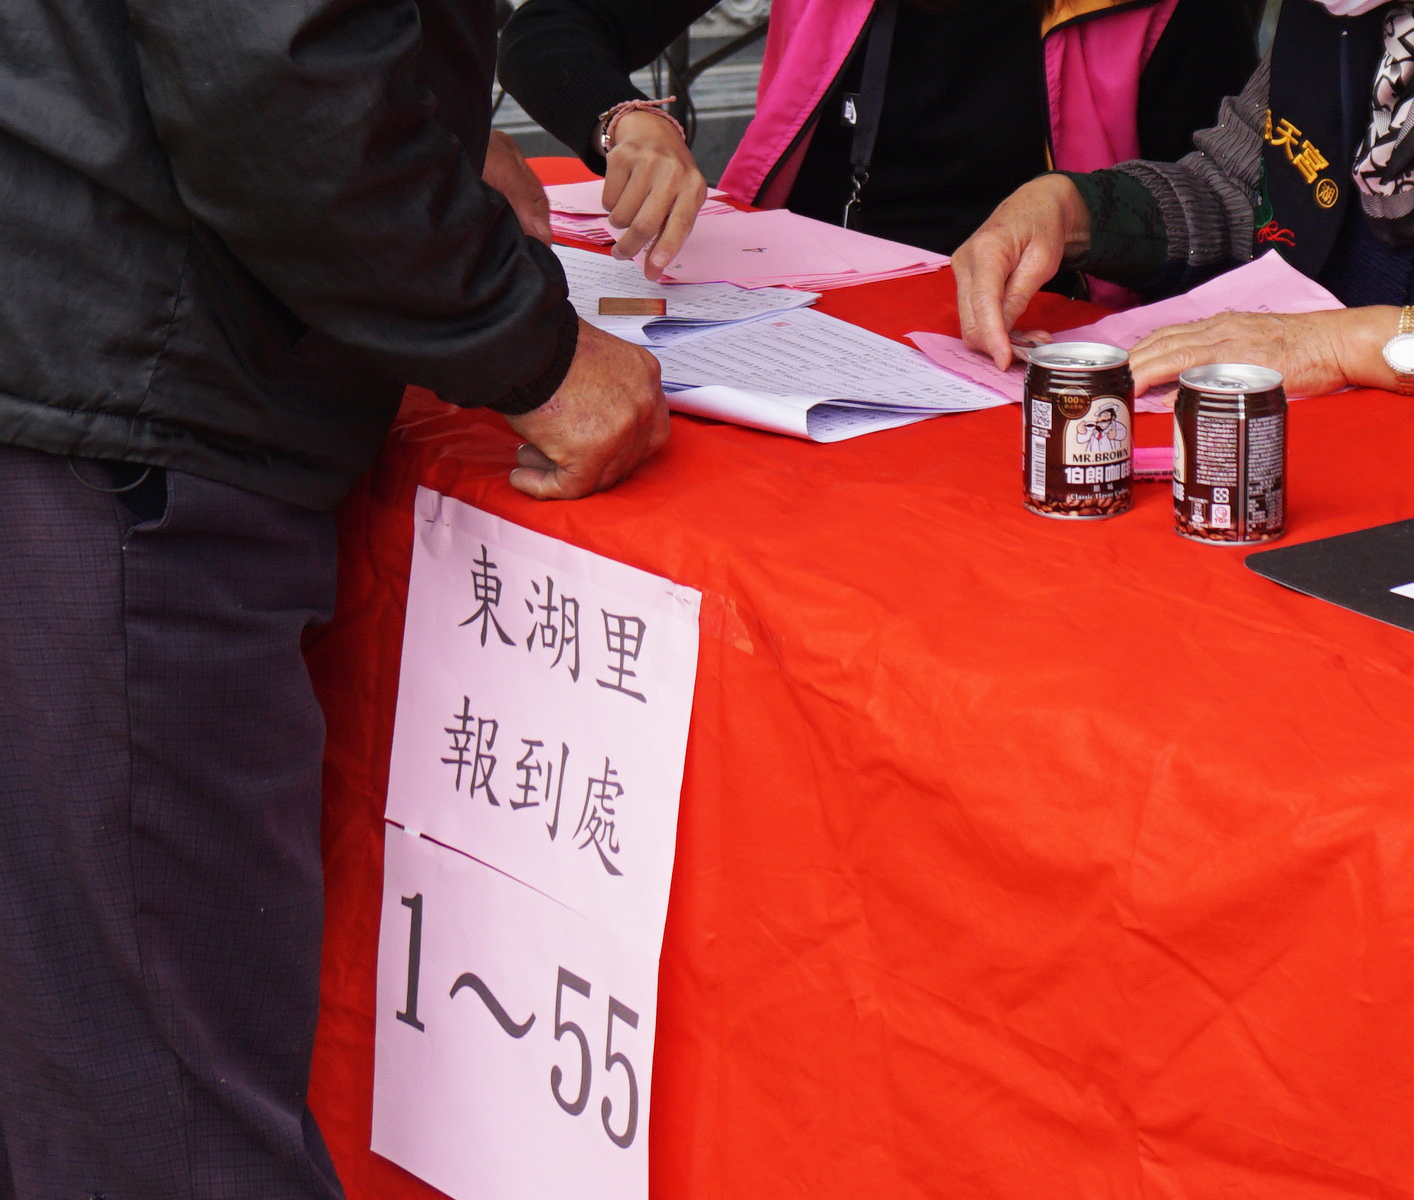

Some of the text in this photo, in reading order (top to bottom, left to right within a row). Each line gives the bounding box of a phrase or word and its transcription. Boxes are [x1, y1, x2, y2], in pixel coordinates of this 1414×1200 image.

[459, 545, 648, 704] 東湖里
[441, 695, 625, 877] 報到處
[395, 892, 641, 1149] 1~55
